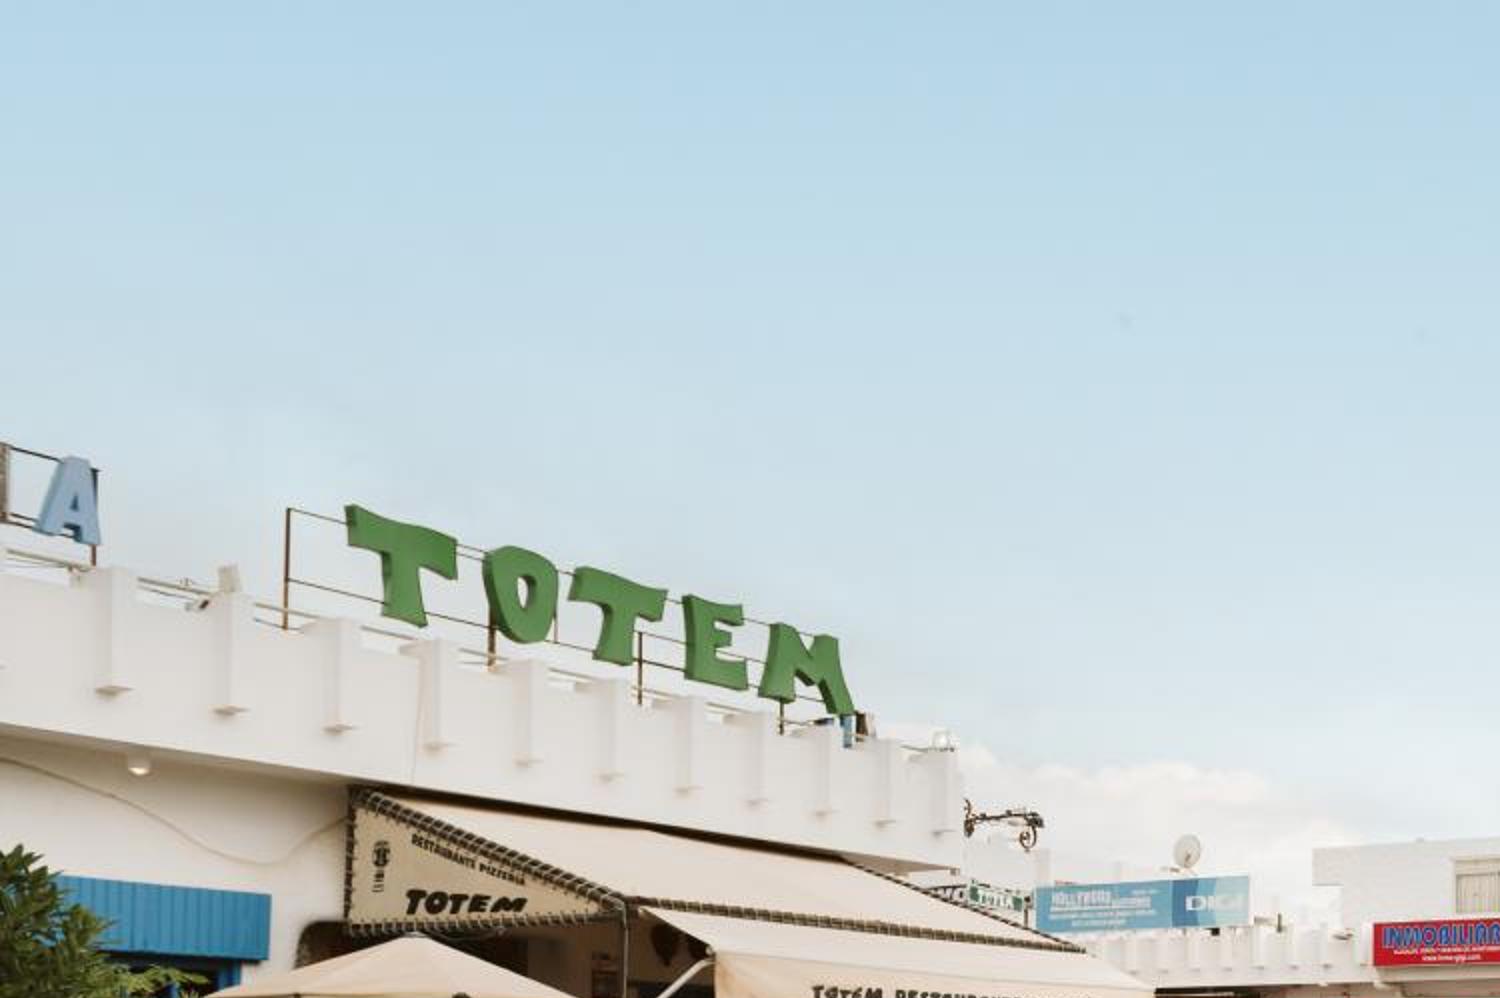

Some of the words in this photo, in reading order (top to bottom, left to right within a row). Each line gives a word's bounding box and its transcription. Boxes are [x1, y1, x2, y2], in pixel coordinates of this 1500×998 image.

[345, 504, 855, 716] TOTEM
[411, 833, 476, 869] RESTAURANTE
[406, 888, 528, 915] TOTEM
